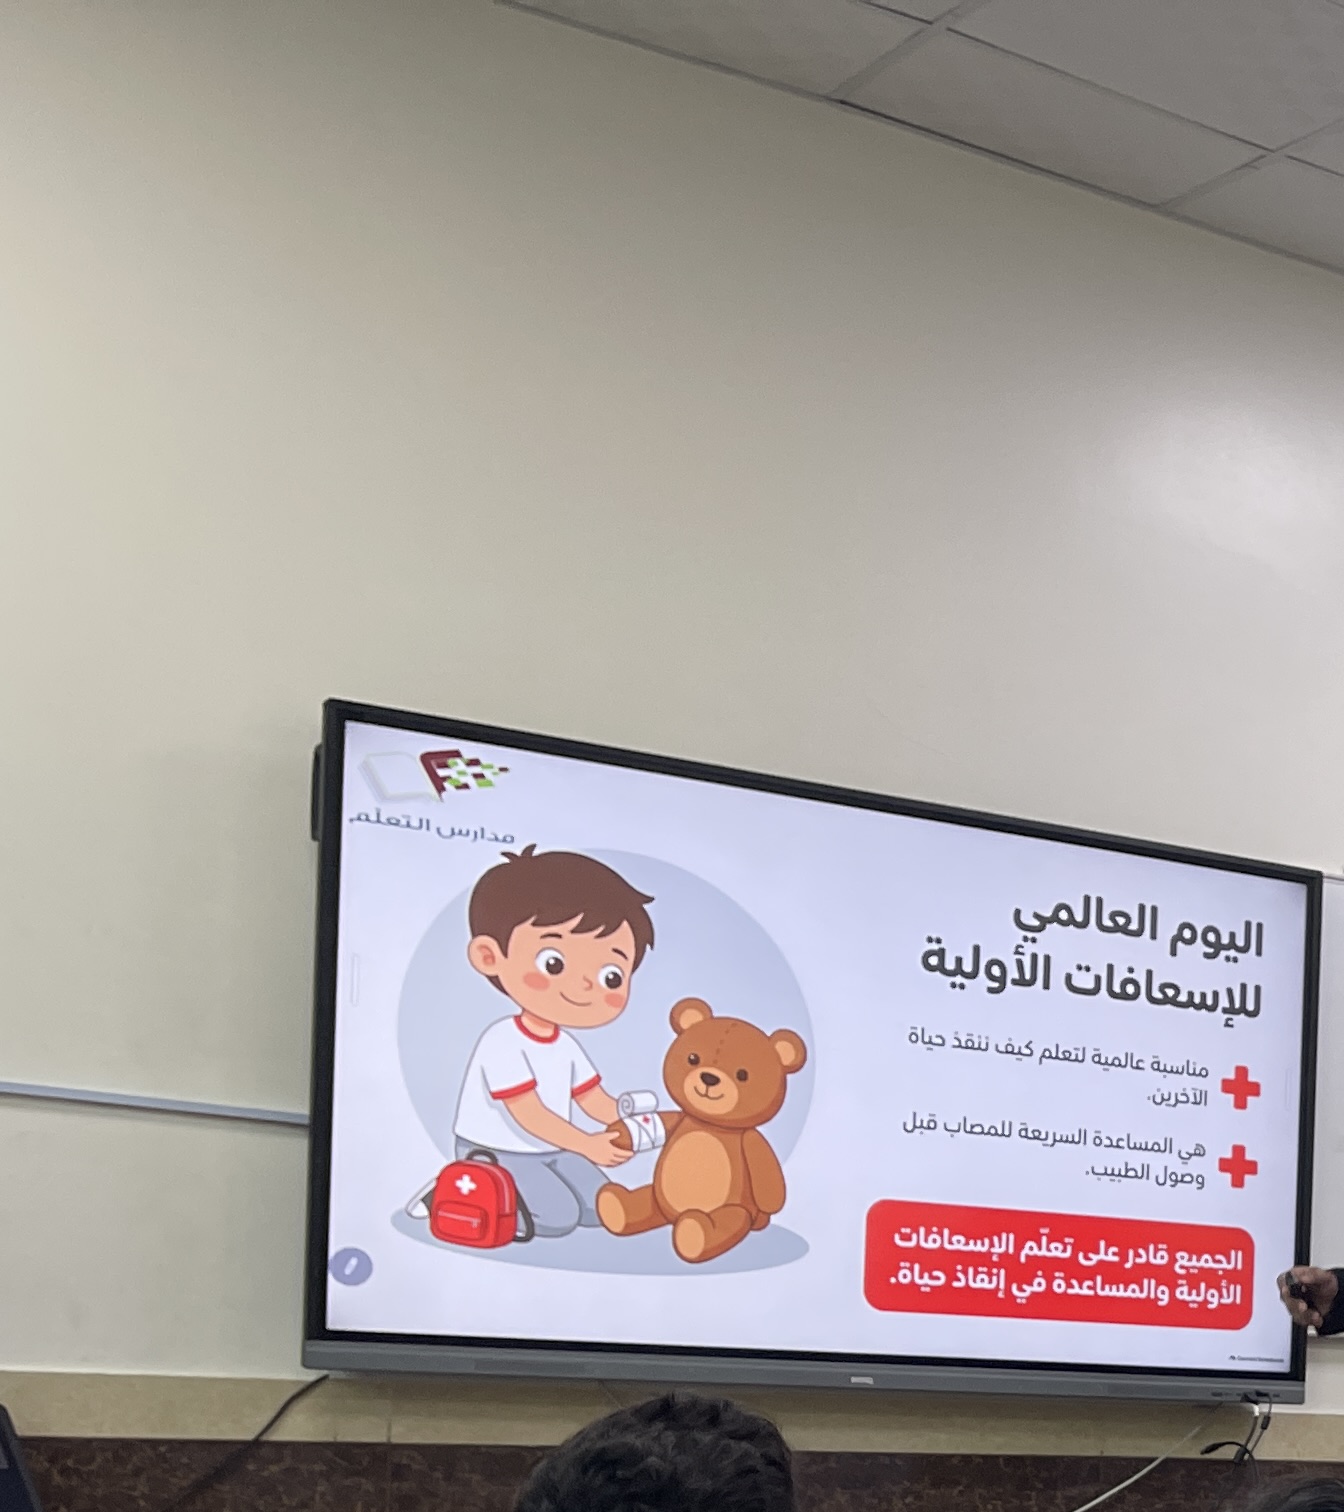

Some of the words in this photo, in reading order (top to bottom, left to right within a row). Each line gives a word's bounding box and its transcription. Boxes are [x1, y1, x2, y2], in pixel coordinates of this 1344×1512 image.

[436, 825, 516, 845] مدارس
[1013, 894, 1159, 944] العالمي
[1170, 920, 1264, 963] اليوم
[921, 935, 1052, 994] الأولية
[1064, 962, 1263, 1029] للإسعافات
[908, 1026, 946, 1053] حياة
[951, 1031, 990, 1053] ننقذ
[994, 1039, 1034, 1062] كيف
[1038, 1043, 1087, 1066] لتعلم
[1091, 1050, 1146, 1072] عالمية
[1150, 1058, 1209, 1079] مناسبة
[1146, 1087, 1208, 1109] الآخرين.
[902, 1112, 938, 1137] قبل
[943, 1118, 1013, 1140] للمصاب
[1017, 1123, 1088, 1148] السريعة
[1092, 1130, 1173, 1156] المساعدة
[1177, 1143, 1206, 1167] هي
[1084, 1161, 1151, 1184] الطبيب.
[1155, 1165, 1206, 1190] وصول
[893, 1226, 1015, 1263] الإسعافات
[1078, 1240, 1120, 1268] على
[1124, 1242, 1169, 1269] قادر
[1173, 1249, 1243, 1276] الجميع
[952, 1268, 1006, 1299] إنقاذ
[1011, 1275, 1047, 1305] في
[1052, 1270, 1170, 1306] والمساعدة
[1175, 1277, 1242, 1308] الأولية
